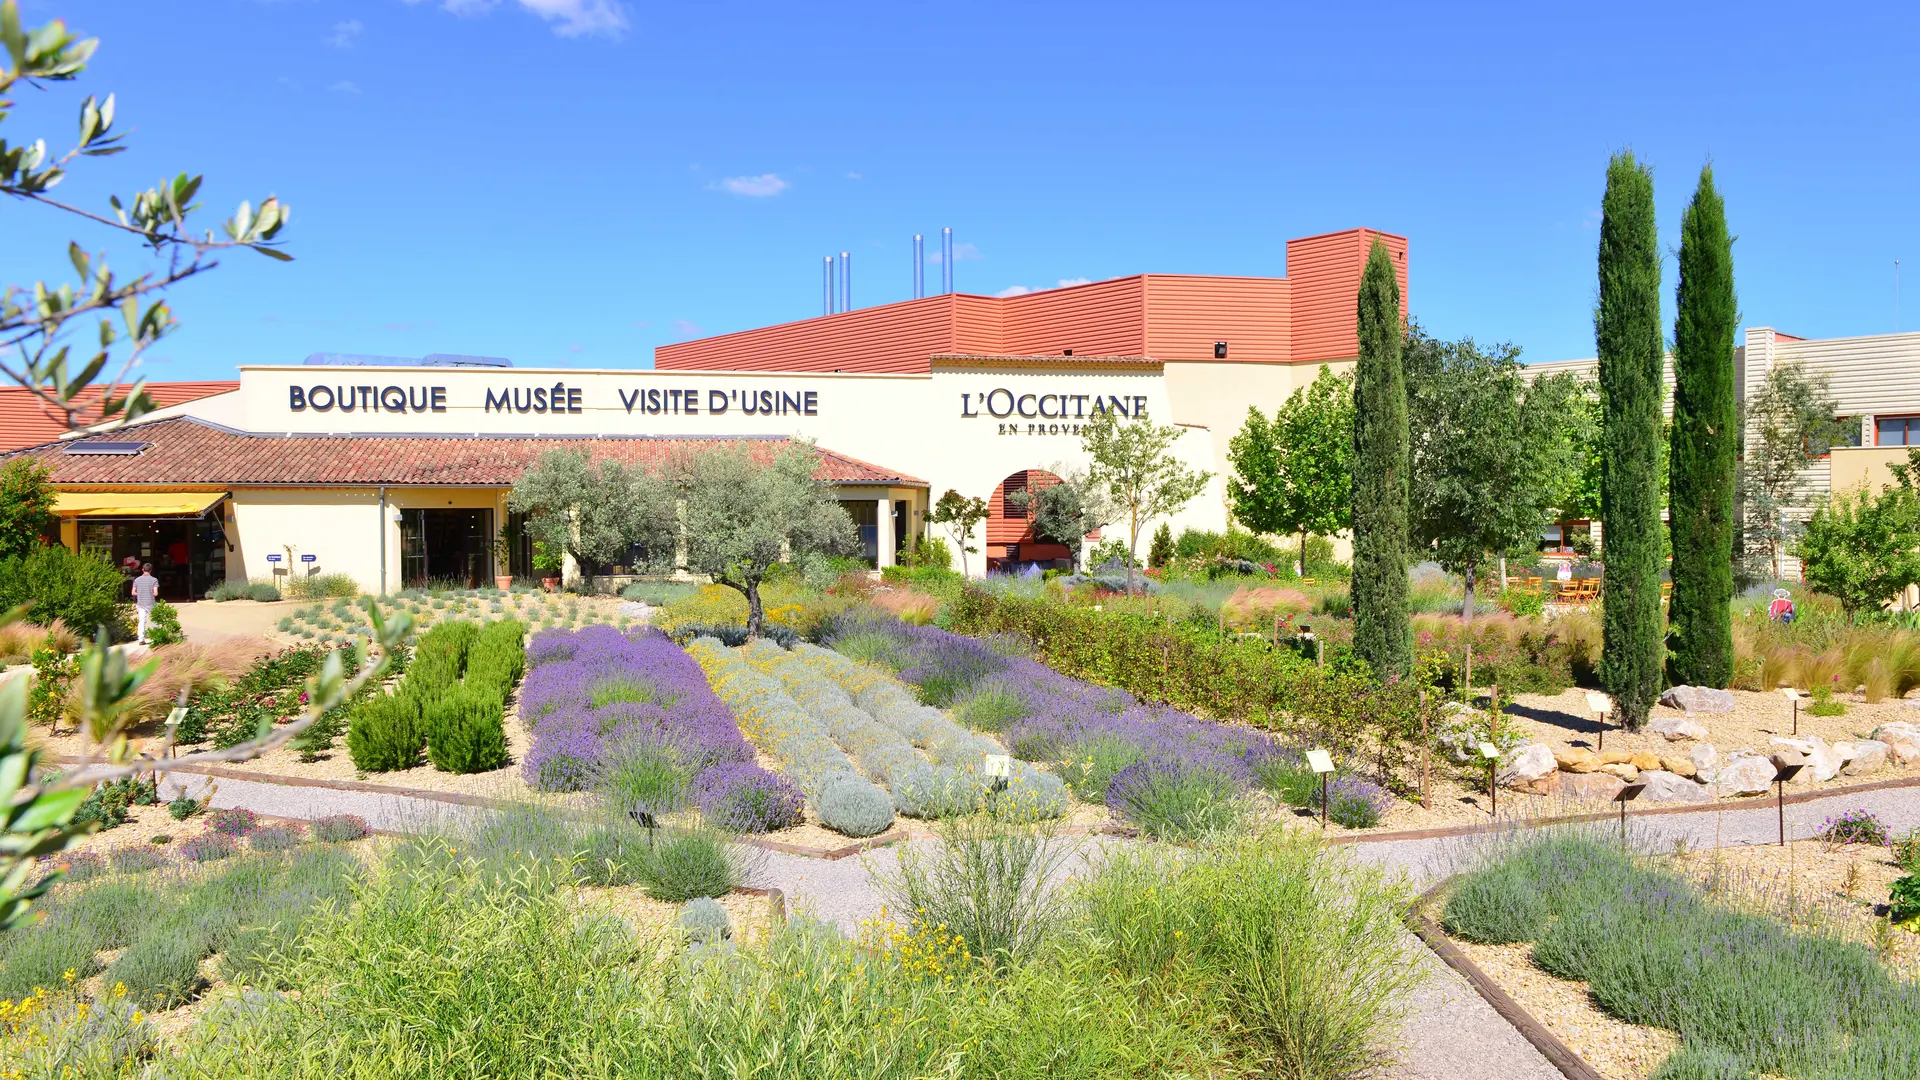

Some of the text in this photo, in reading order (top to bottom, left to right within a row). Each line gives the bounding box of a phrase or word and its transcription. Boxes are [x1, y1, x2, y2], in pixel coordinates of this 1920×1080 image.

[289, 382, 817, 415] BOUTIQUE MUSÉE VISITE D'USINE
[961, 388, 1148, 419] L'OCCITANE
[998, 424, 1112, 436] EN PROVE
